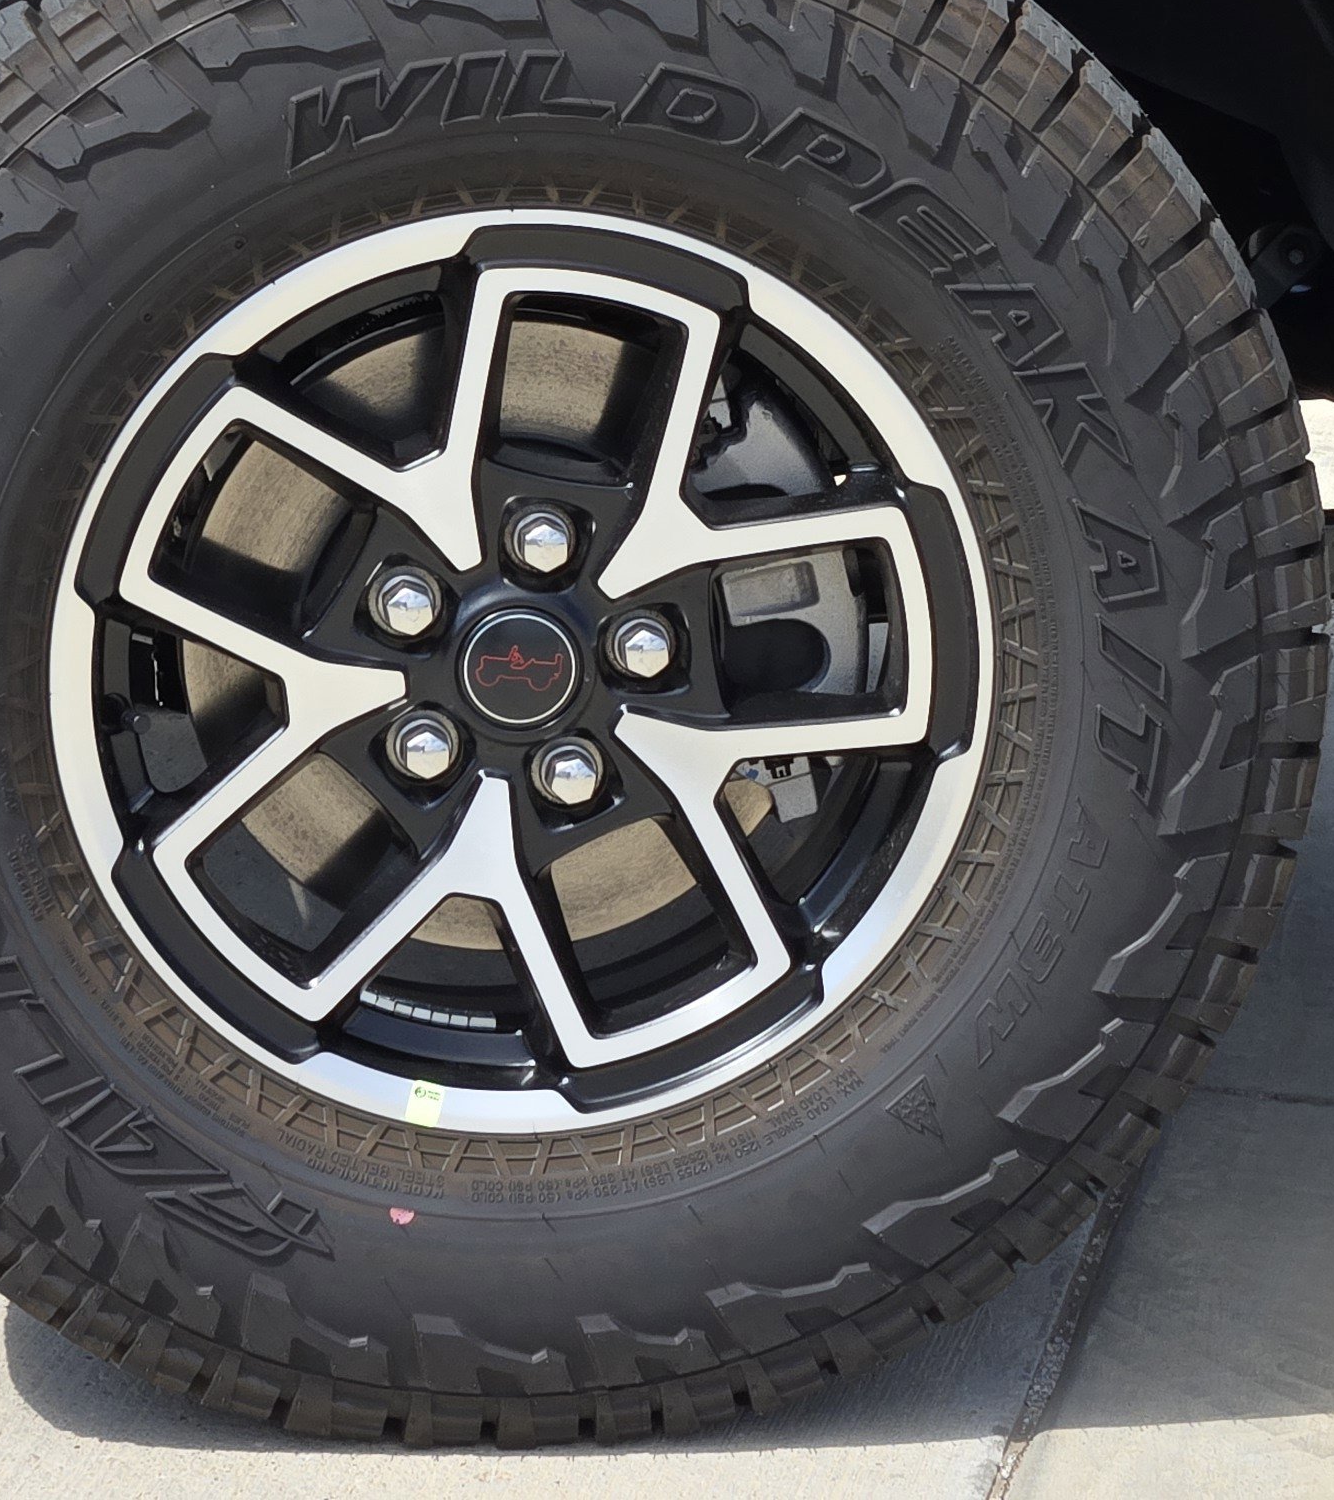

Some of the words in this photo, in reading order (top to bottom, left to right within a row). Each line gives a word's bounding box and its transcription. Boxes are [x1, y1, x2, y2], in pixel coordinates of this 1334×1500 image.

[284, 48, 1134, 470] WILDPEAK
[1072, 497, 1165, 806] A/T
[827, 1064, 857, 1091] MAX.
[834, 1073, 864, 1100] MAX.
[796, 1084, 830, 1112] LOAD
[803, 1093, 837, 1122] LOAD
[764, 1104, 799, 1131] DUAL
[726, 1126, 756, 1148] 1150
[763, 1116, 804, 1146] SINGLE
[275, 1127, 327, 1160] RADIAL
[732, 1138, 762, 1161] 1250
[327, 1148, 390, 1180] BELTED
[638, 1159, 671, 1178] LBS)
[713, 1149, 732, 1166] kg
[394, 1166, 446, 1188] STEEL
[618, 1167, 636, 1182] AT
[641, 1170, 674, 1190] LBS)
[675, 1157, 714, 1181] (2755
[403, 1182, 445, 1200] MADE
[470, 1178, 504, 1192] COLD
[621, 1178, 640, 1194] AT
[470, 1190, 504, 1204] COLD
[538, 1190, 561, 1203] (50
